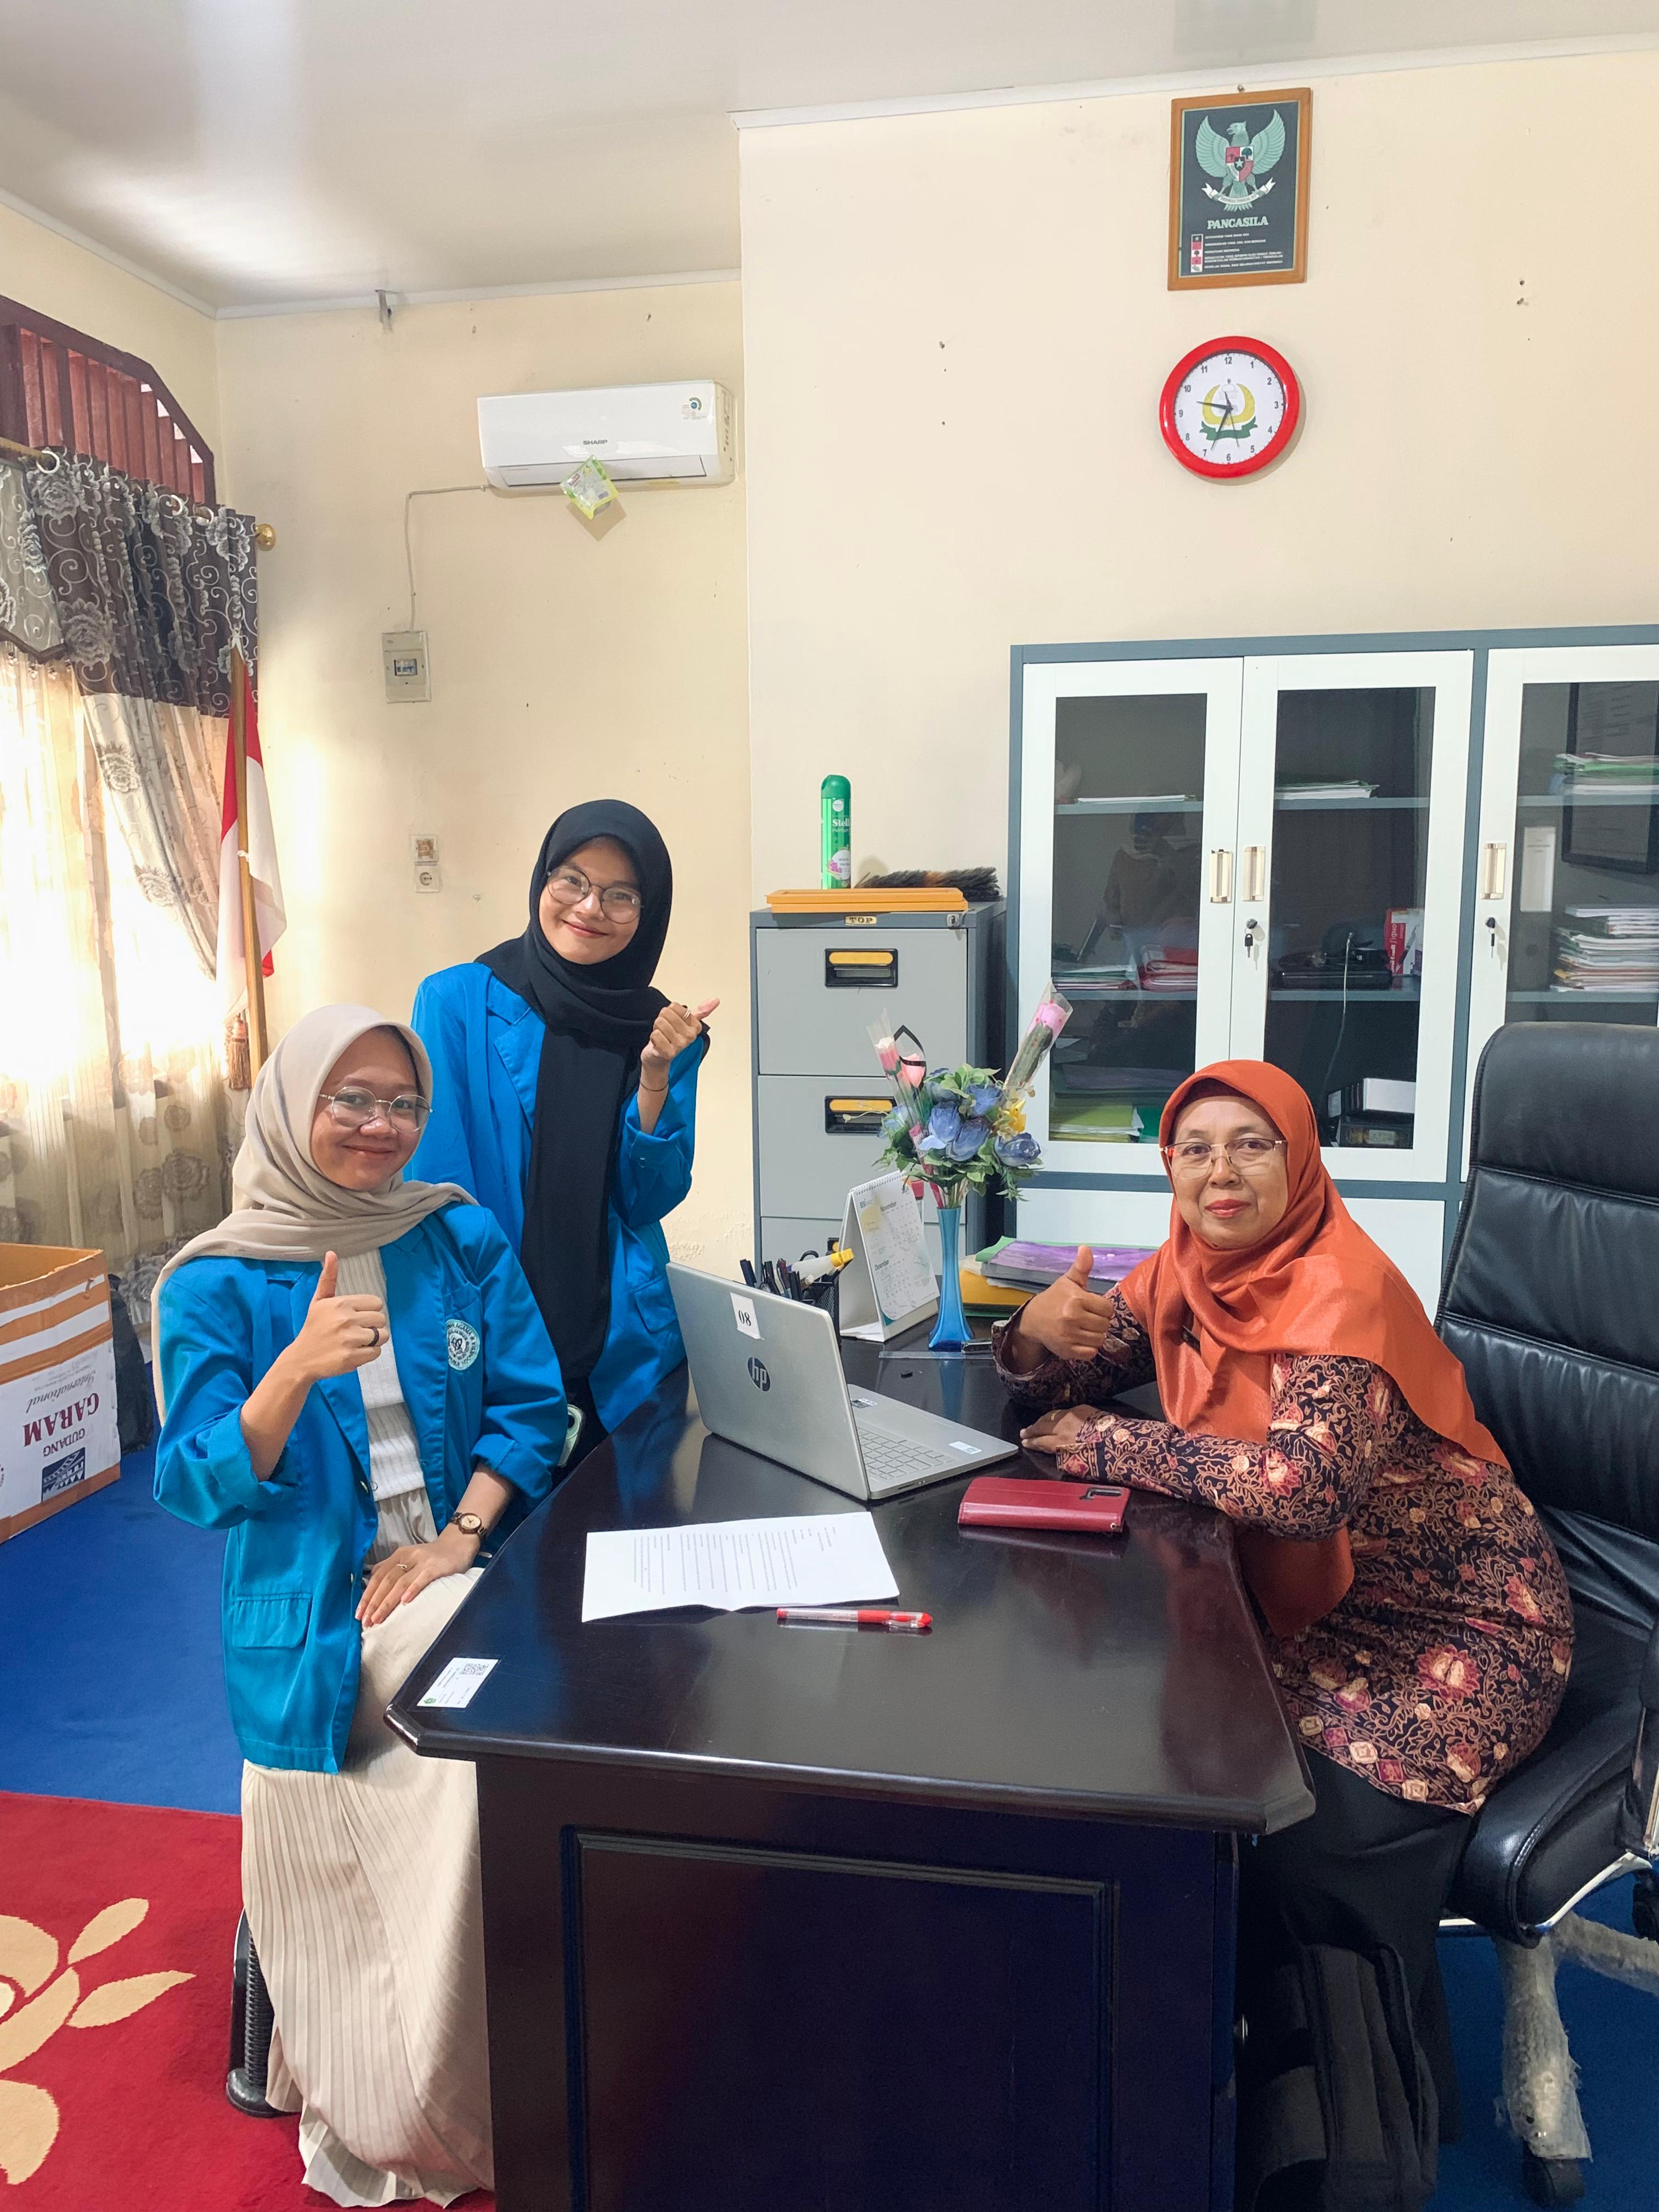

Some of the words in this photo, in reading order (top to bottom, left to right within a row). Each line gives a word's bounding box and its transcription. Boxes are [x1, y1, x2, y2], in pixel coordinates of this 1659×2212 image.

[1207, 216, 1268, 229] PANCASILA
[1250, 445, 1255, 453] 5
[832, 818, 850, 827] Stell
[880, 1201, 896, 1211] November
[738, 1310, 751, 1327] 08
[751, 1357, 768, 1391] hp
[26, 1369, 96, 1413] International
[22, 1392, 100, 1447] GARAM
[43, 1427, 86, 1458] GUDANG
